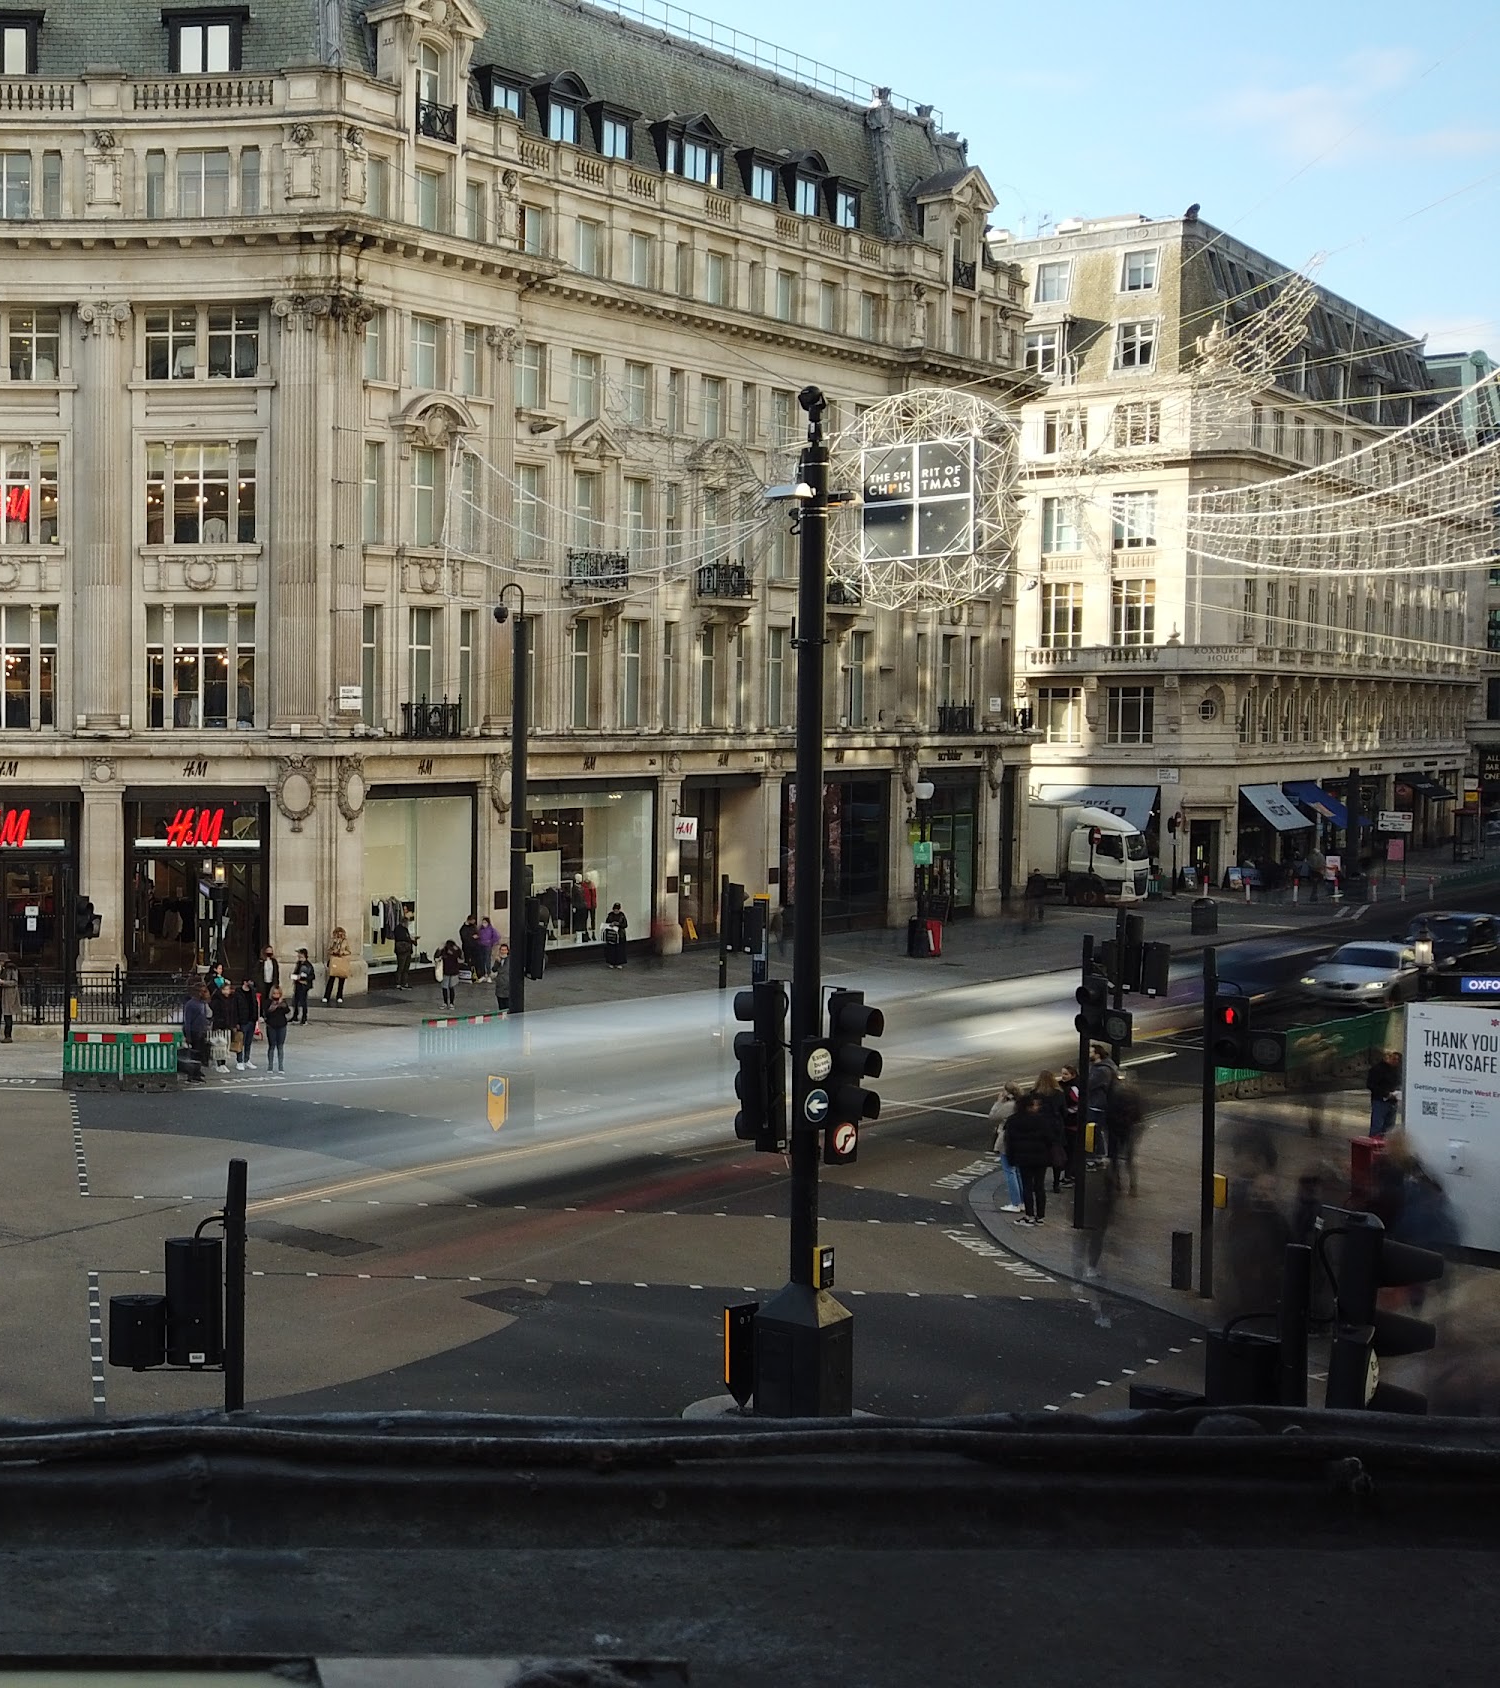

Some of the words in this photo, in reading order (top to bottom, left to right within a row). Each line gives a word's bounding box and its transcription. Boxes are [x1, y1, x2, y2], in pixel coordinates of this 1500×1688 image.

[869, 472, 891, 483] THE
[893, 467, 940, 481] SPIRIT
[945, 464, 962, 476] OF
[868, 476, 961, 497] CHRISTMAS
[182, 760, 208, 777] H&M
[418, 759, 432, 775] H&M
[166, 808, 224, 848] H&M
[675, 822, 693, 834] H&M
[1468, 980, 1500, 990] OXFO
[1424, 1029, 1468, 1050] THANK
[1472, 1033, 1498, 1053] YOU
[1424, 1050, 1497, 1074] #STAYSAFE
[1414, 1082, 1437, 1093] Getting
[1438, 1087, 1461, 1095] around
[1462, 1087, 1474, 1095] the
[1474, 1089, 1492, 1097] West
[994, 1261, 1057, 1283] LOOK
